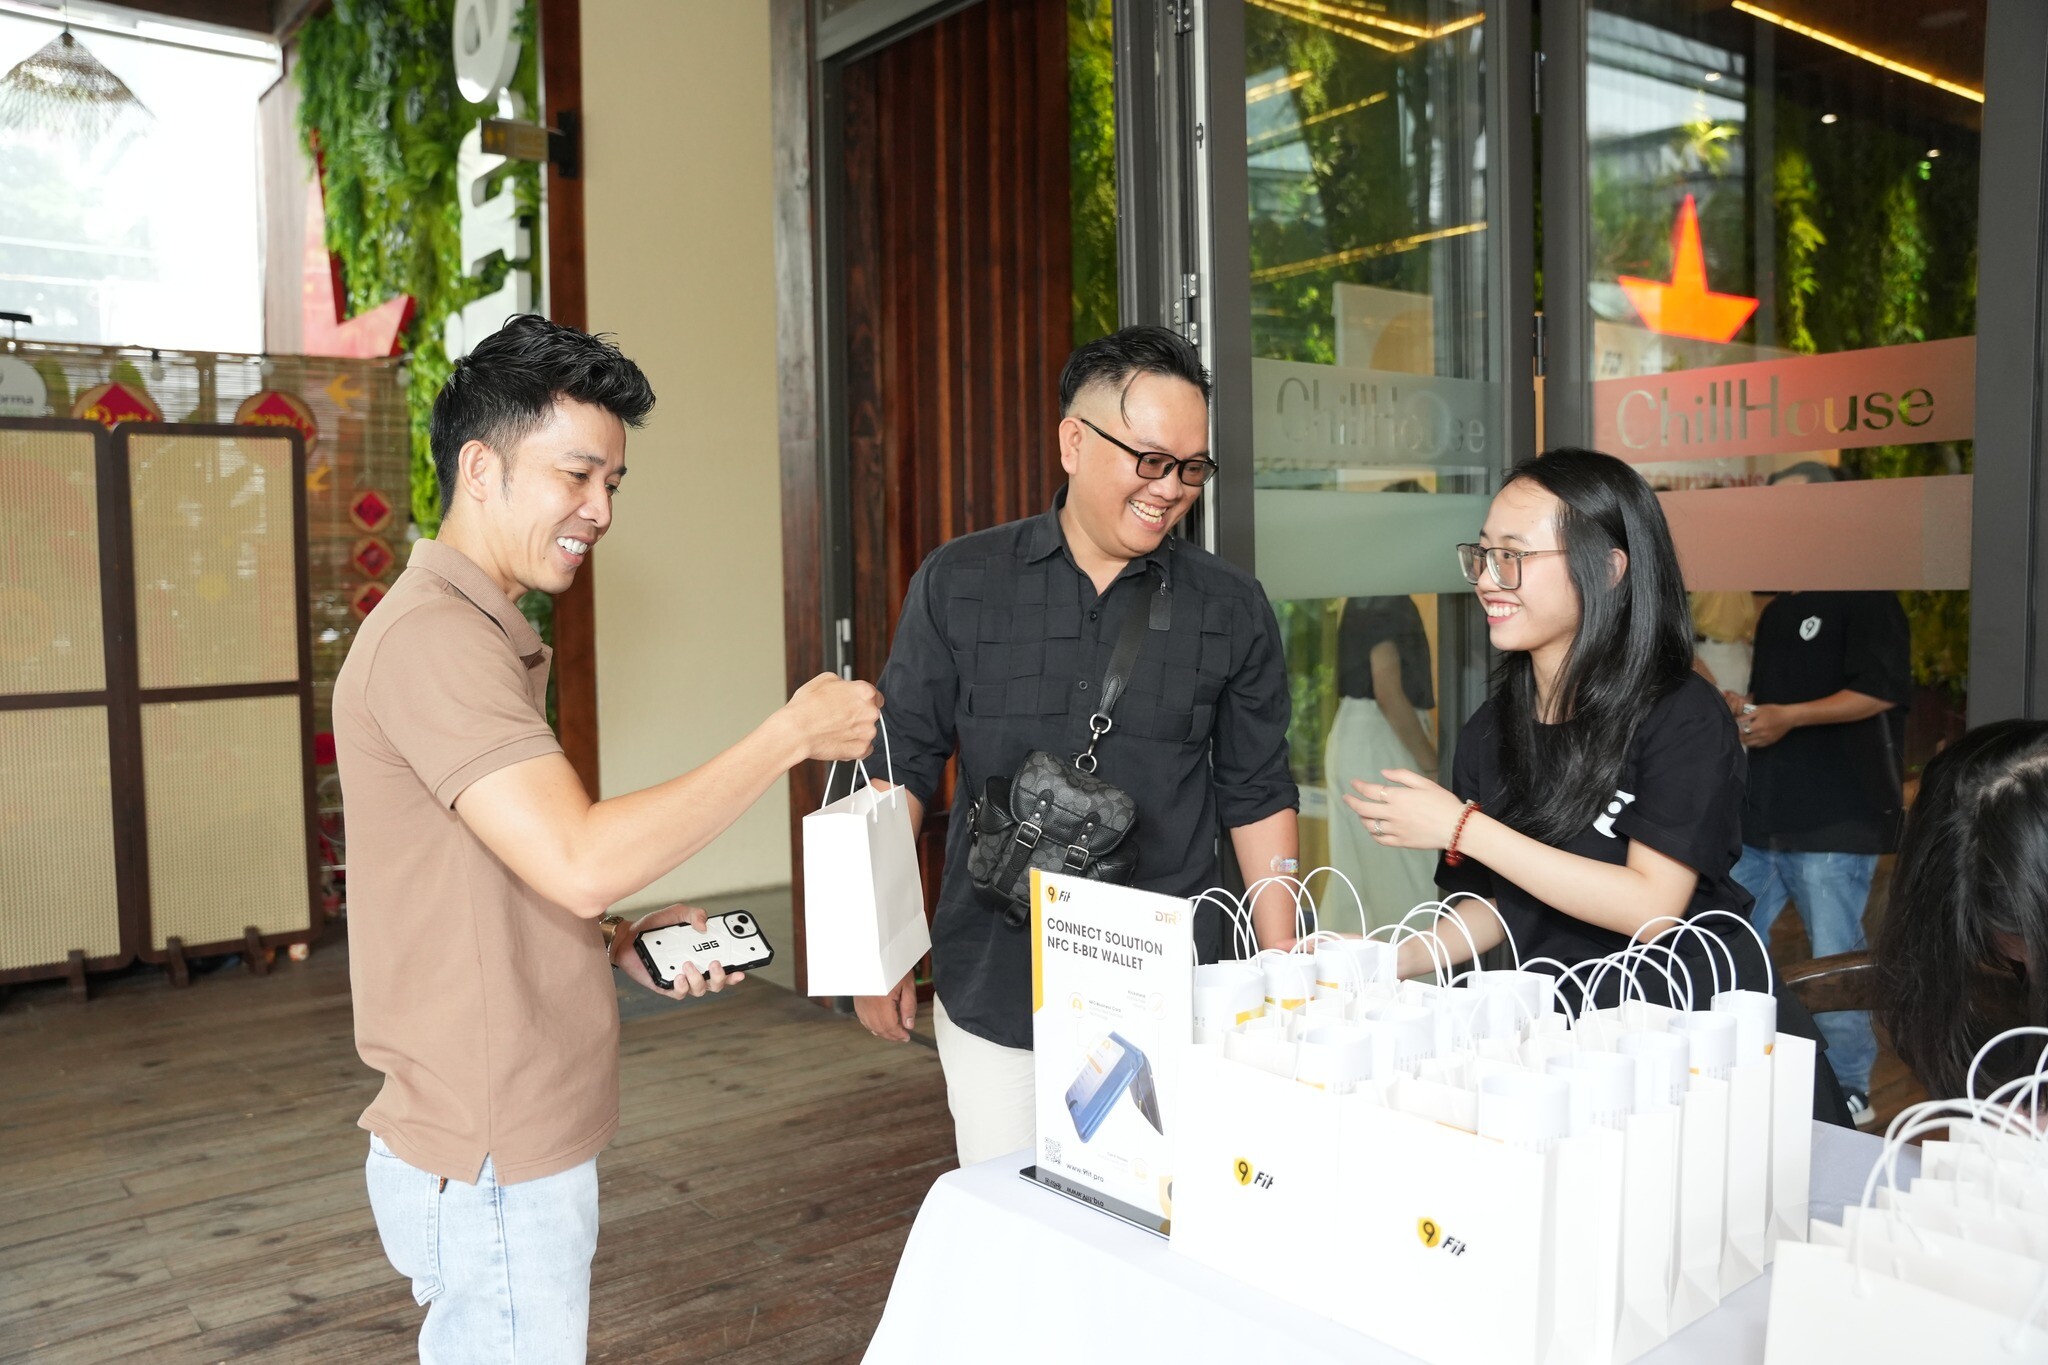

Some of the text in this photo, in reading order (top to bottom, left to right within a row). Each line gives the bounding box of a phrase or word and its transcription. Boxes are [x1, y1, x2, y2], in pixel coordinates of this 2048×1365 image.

[1615, 374, 1935, 451] ChillHouse
[1058, 890, 1071, 903] Fit
[1047, 917, 1163, 956] CONNECT SOLUTION
[1047, 936, 1143, 971] NFC E-BIZ WALLET
[1254, 1170, 1274, 1190] Fit
[1442, 1235, 1467, 1257] Fit
